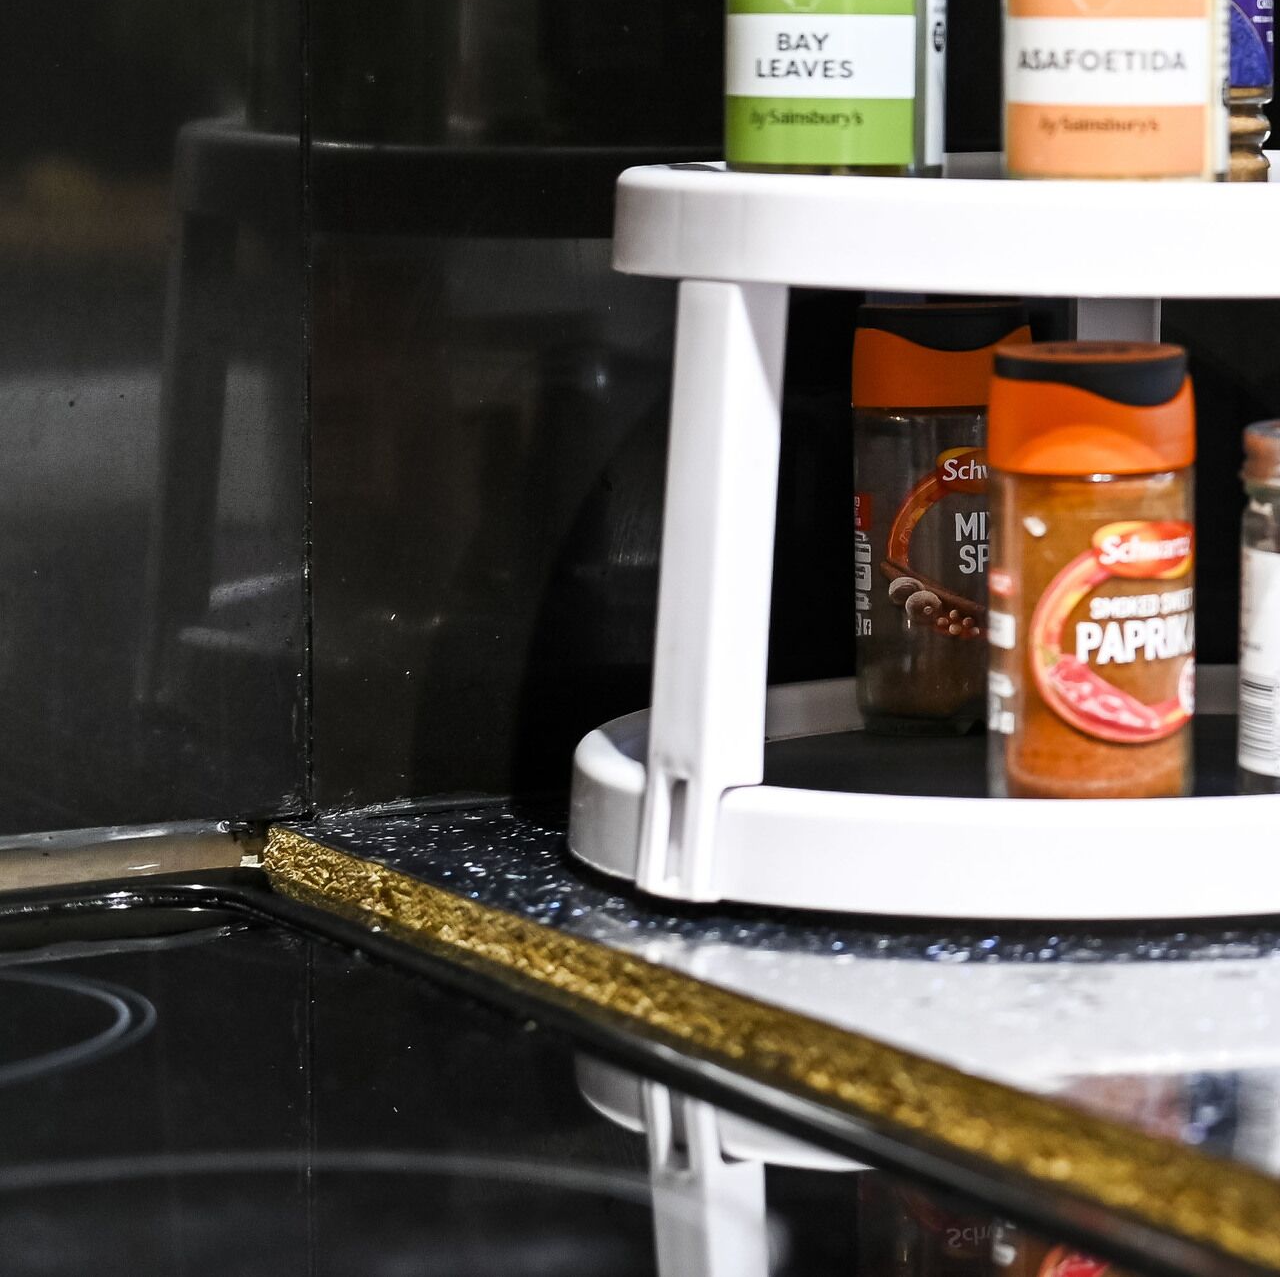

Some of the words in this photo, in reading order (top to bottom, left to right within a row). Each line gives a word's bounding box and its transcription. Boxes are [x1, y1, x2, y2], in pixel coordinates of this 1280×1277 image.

[777, 32, 829, 51] BAY
[755, 58, 854, 79] LEAVES
[1016, 48, 1188, 72] ASAFOETIDA
[954, 511, 990, 542] MI
